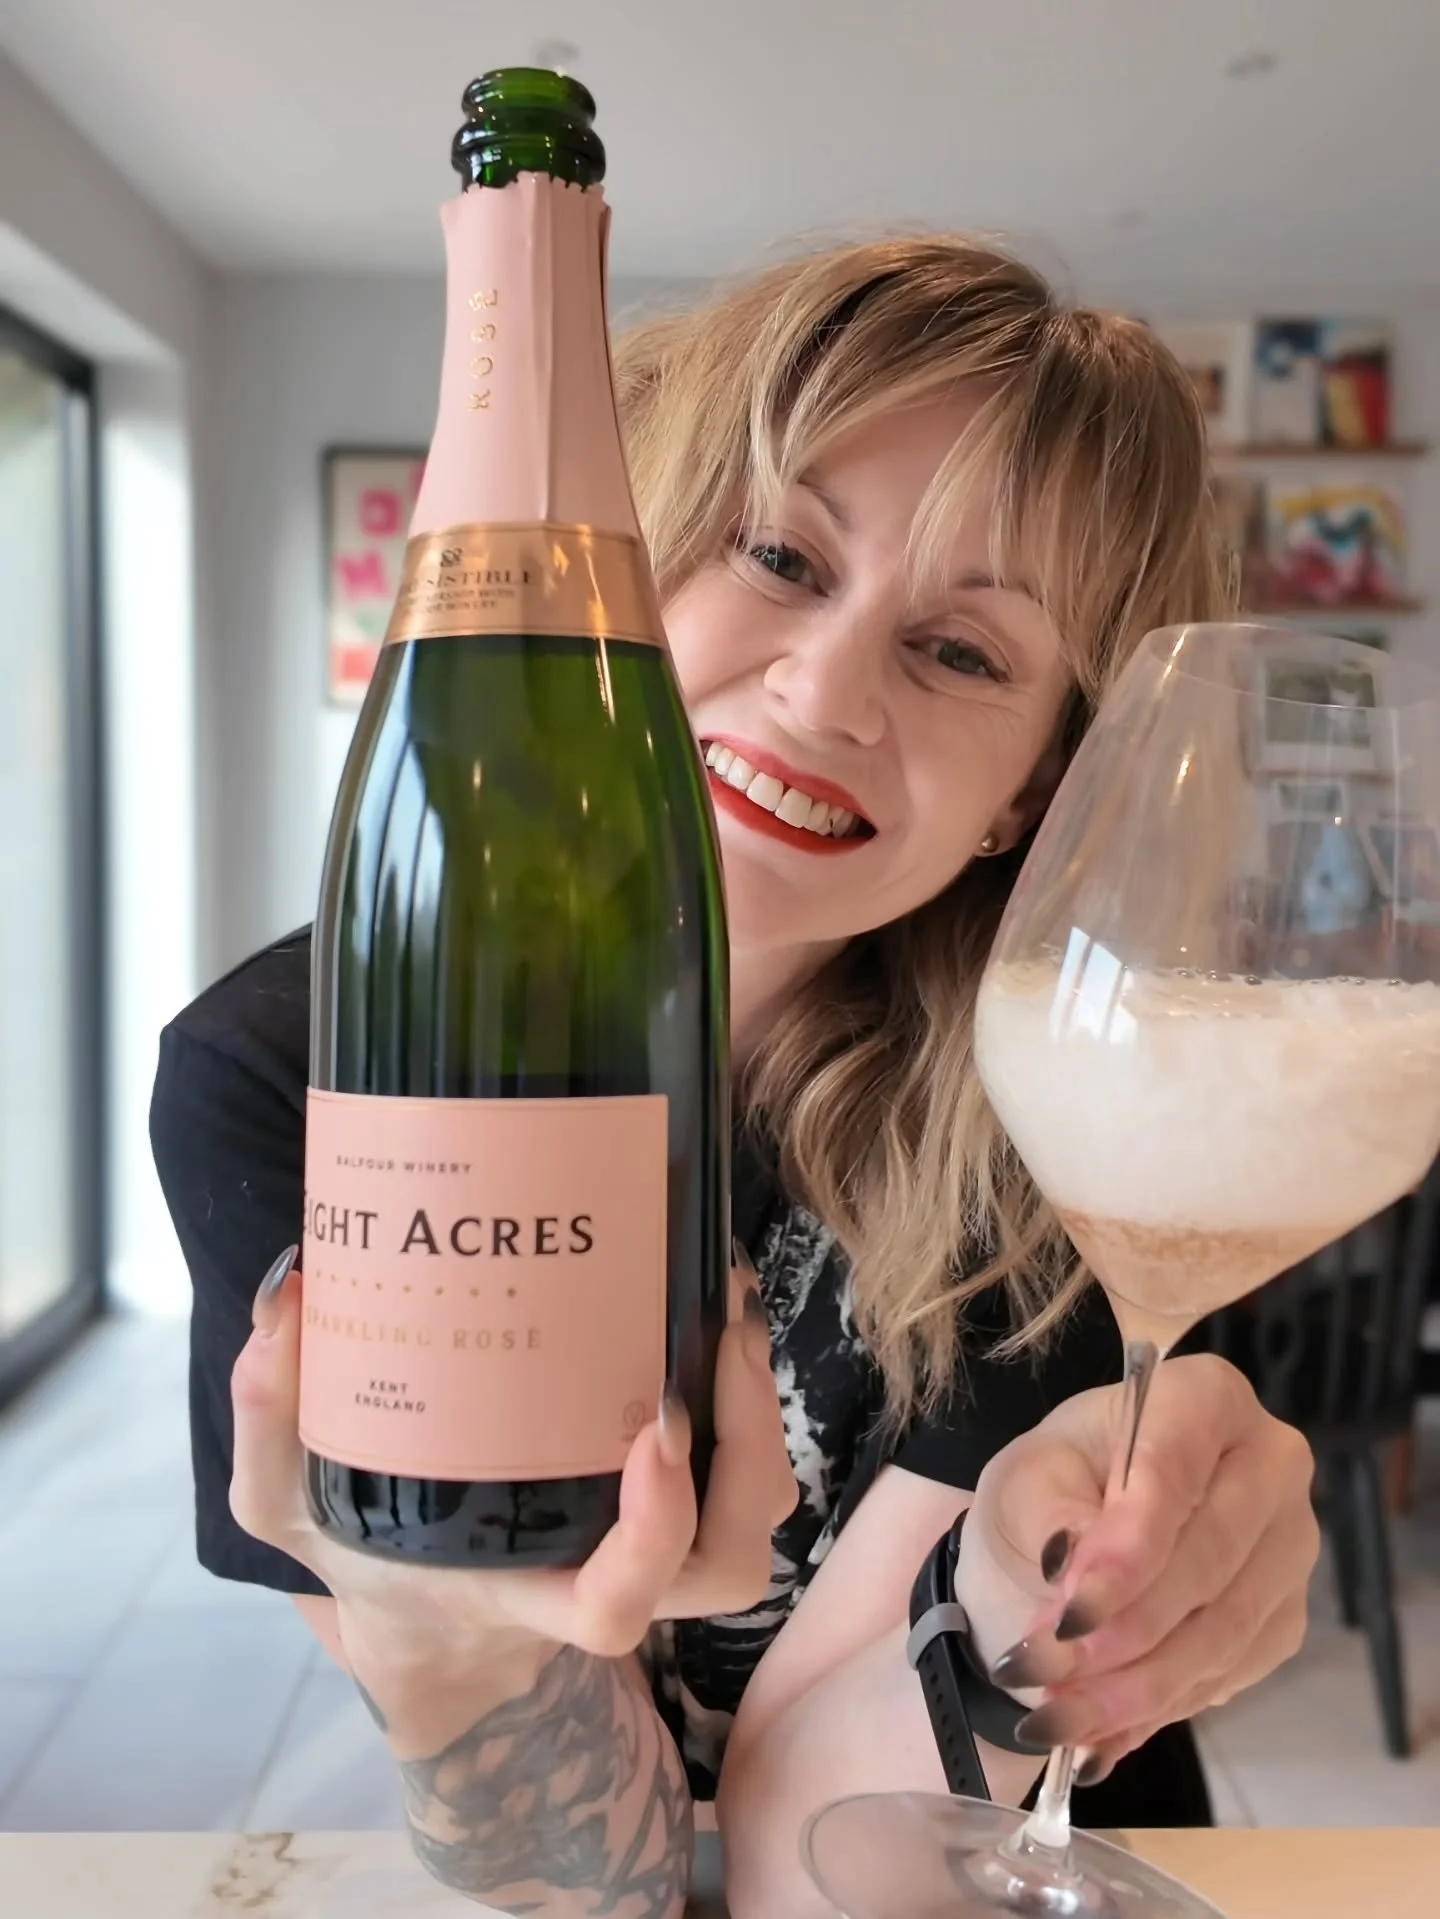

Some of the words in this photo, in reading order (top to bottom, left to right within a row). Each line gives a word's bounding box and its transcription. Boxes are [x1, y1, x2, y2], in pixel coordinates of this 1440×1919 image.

[335, 1154, 396, 1170] BALFOUR
[403, 1161, 473, 1174] WINERY
[304, 1191, 379, 1250] IGHT
[399, 1208, 595, 1257] ACRES
[369, 1379, 408, 1395] KENT
[355, 1392, 427, 1414] ENGLAND
